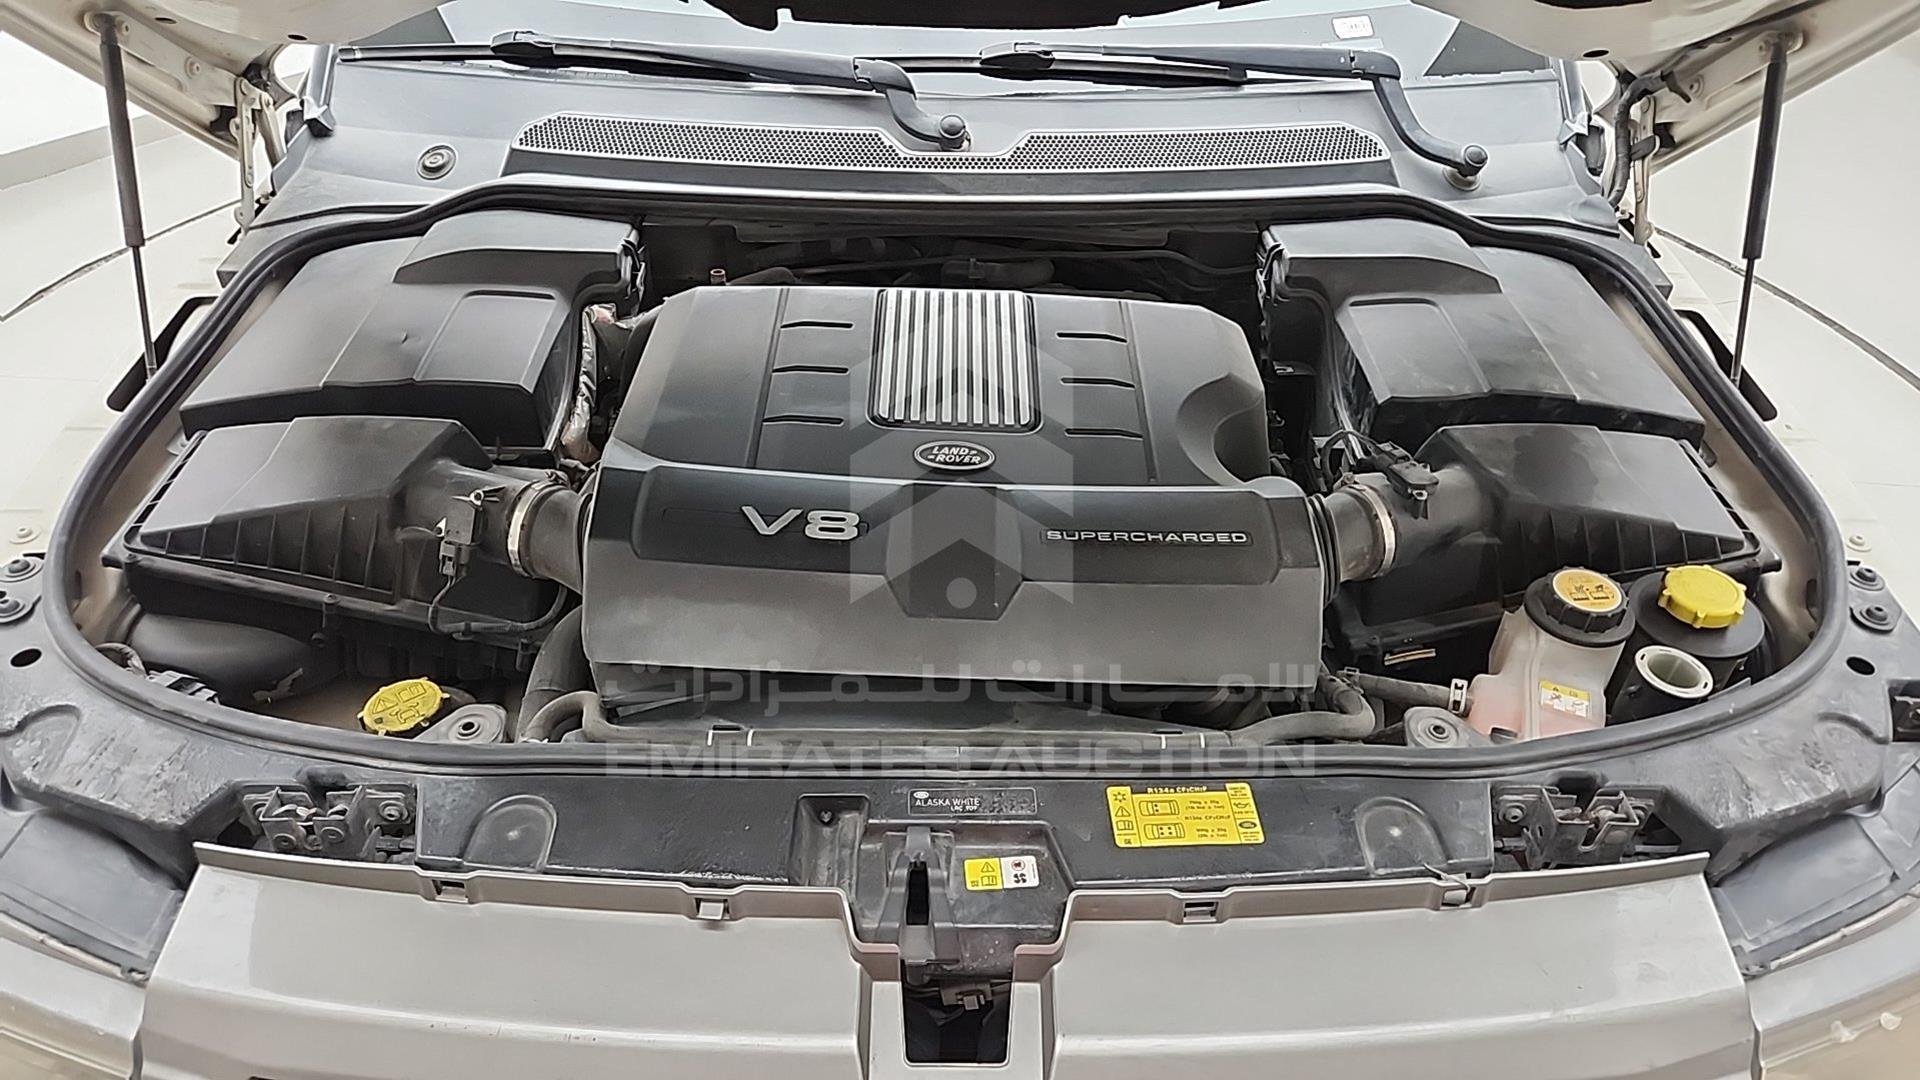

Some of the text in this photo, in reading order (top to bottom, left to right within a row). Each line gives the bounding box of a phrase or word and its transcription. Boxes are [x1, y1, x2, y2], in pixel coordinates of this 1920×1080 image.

[932, 446, 969, 455] LAND
[935, 454, 981, 464] ROVER
[741, 505, 860, 540] V8
[1046, 530, 1248, 543] SUPERCHARGED
[915, 797, 980, 807] ALASKA WHITE
